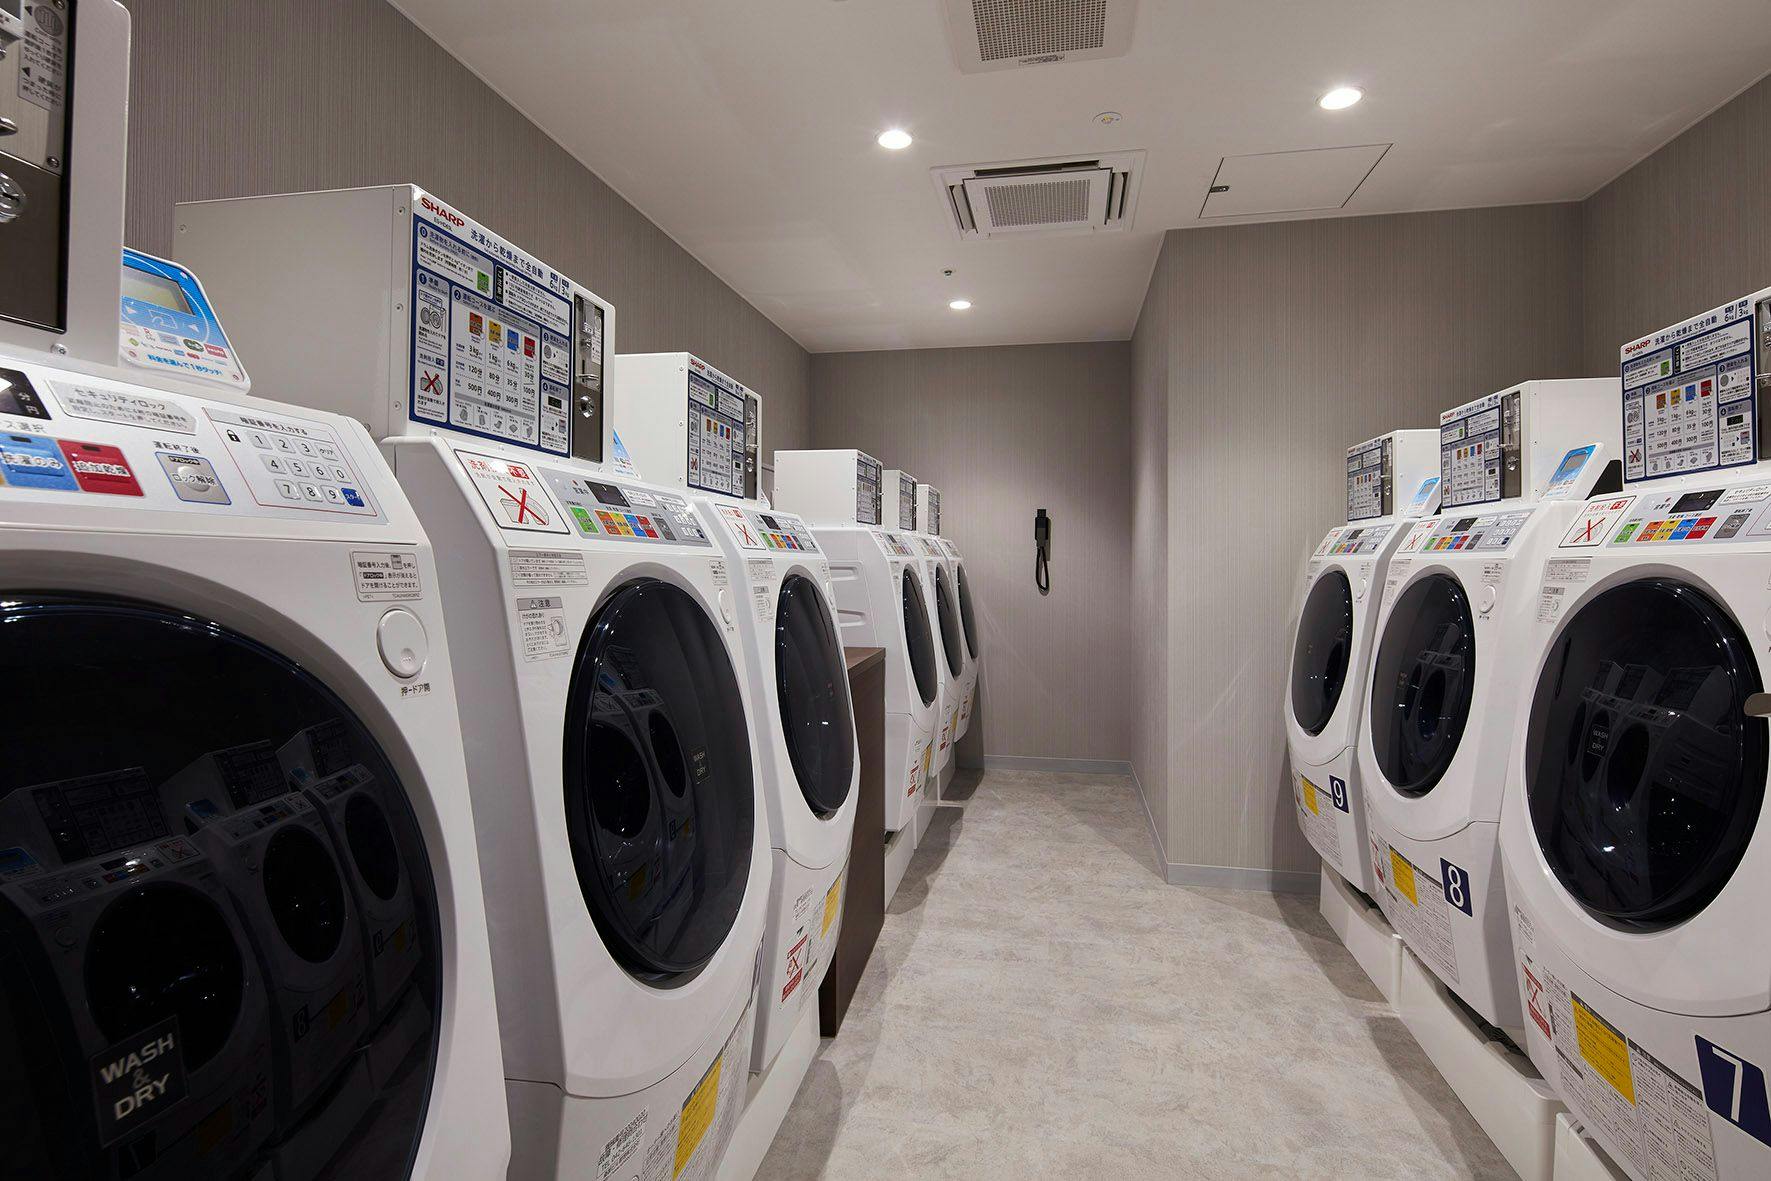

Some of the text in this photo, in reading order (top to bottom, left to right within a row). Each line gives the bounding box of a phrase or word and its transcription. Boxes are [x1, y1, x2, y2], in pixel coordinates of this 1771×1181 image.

[421, 197, 465, 228] SHARP
[1624, 339, 1651, 355] SHARP
[26, 405, 40, 415] 円
[256, 434, 264, 445] 1
[278, 439, 288, 449] 2
[301, 443, 310, 453] 3
[270, 459, 345, 480] 4 5 6 0
[283, 484, 293, 495] 7
[307, 486, 316, 498] 8
[329, 489, 337, 500] 9
[1591, 742, 1605, 752] DRY
[1333, 779, 1343, 808] 9
[1447, 864, 1464, 908] 8
[100, 1032, 175, 1085] WASH
[132, 1067, 152, 1090] &
[1711, 1045, 1744, 1123] 7
[113, 1072, 170, 1121] DRY
